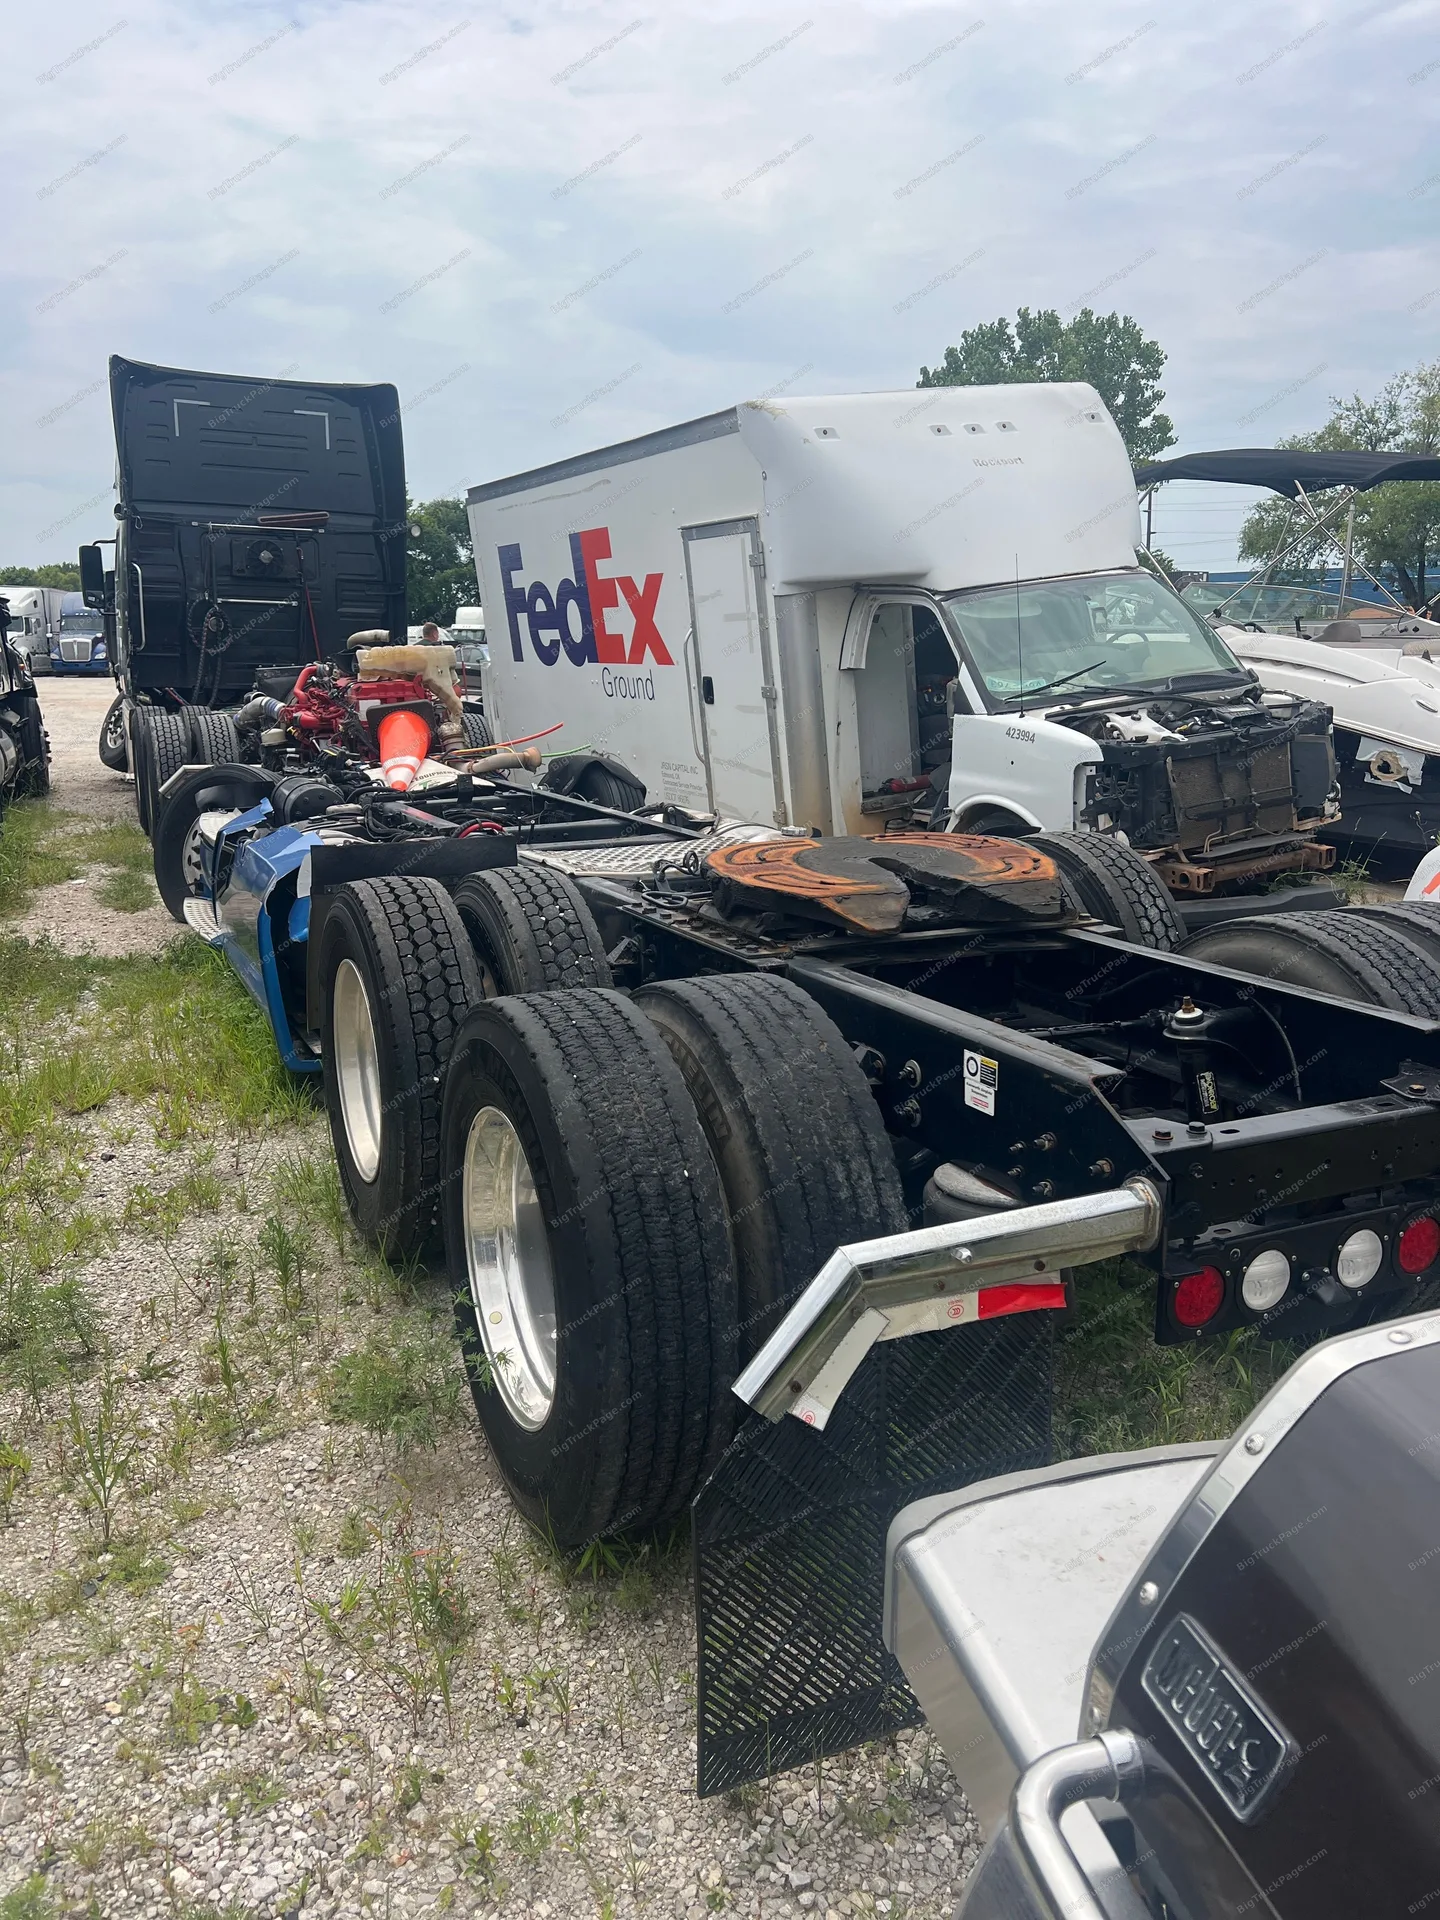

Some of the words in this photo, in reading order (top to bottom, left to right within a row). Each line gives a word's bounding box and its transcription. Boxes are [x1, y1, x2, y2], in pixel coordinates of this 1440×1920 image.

[497, 527, 676, 667] FedEx
[602, 667, 655, 701] Ground
[1006, 727, 1036, 744] 423994
